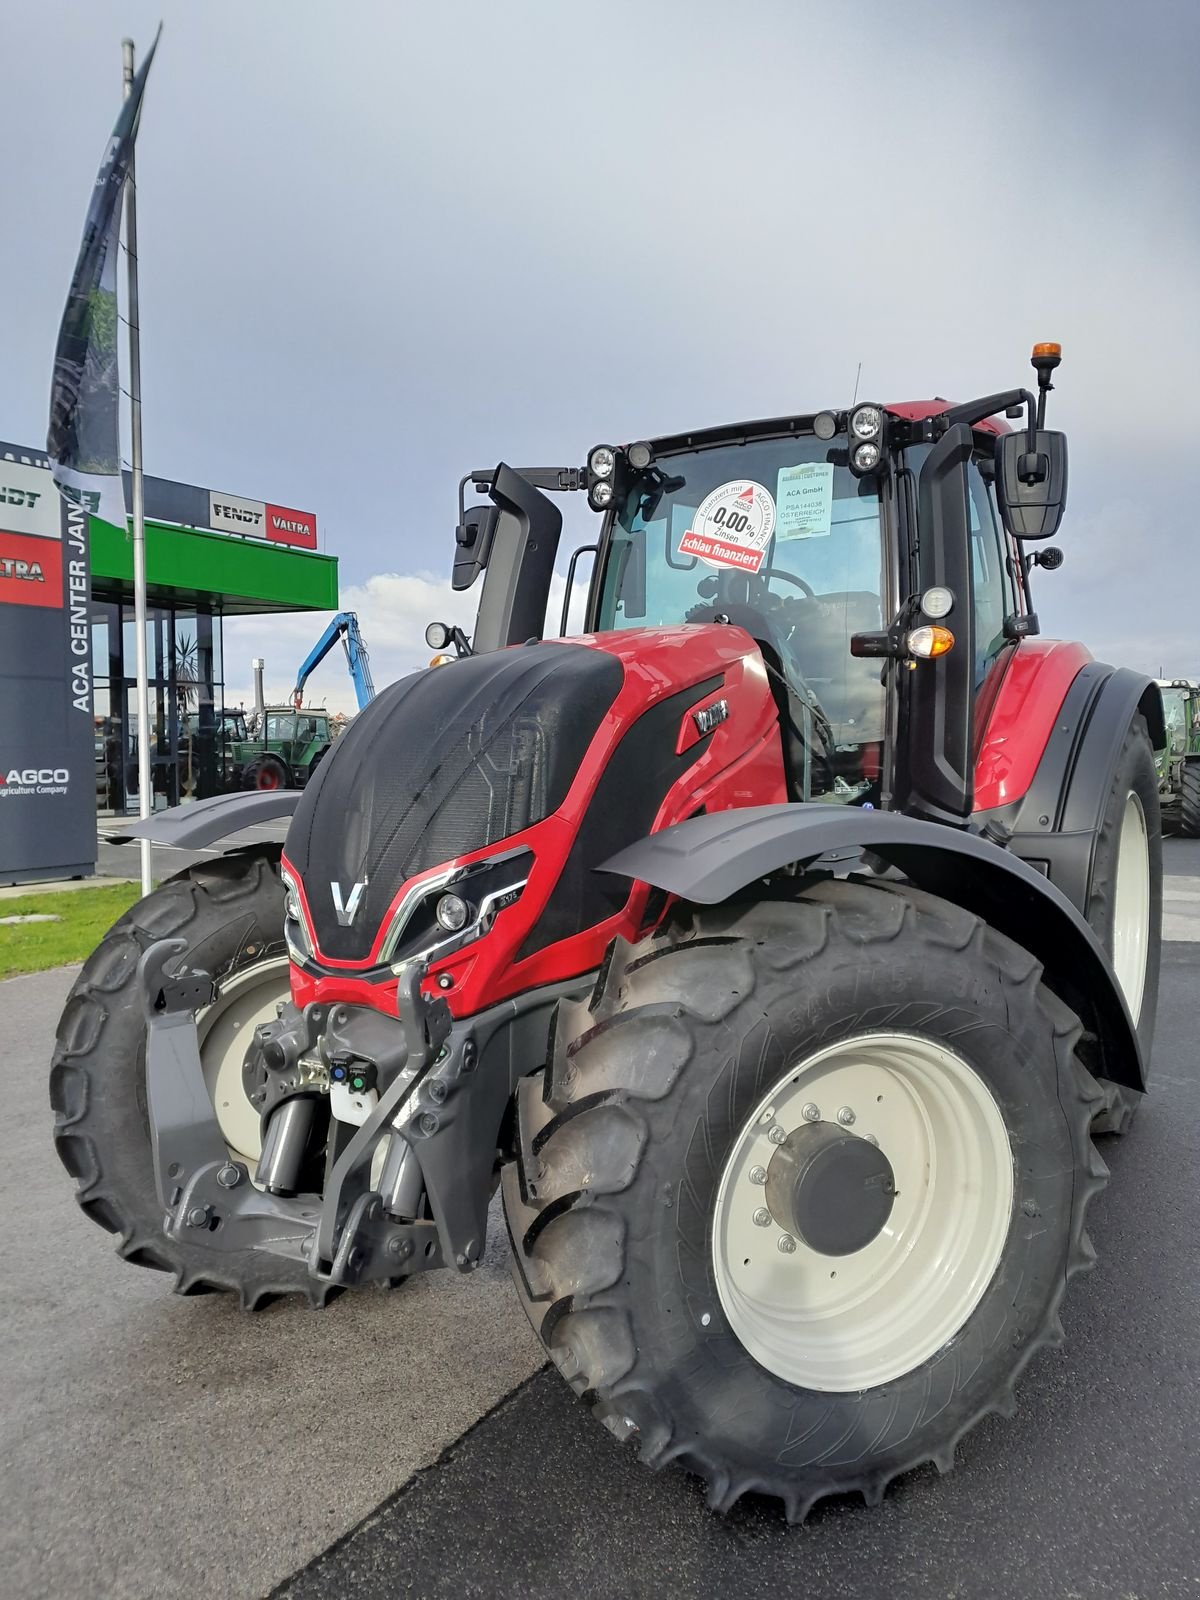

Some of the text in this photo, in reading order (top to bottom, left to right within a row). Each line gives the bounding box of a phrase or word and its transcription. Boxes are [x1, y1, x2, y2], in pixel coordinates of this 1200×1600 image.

[786, 486, 823, 497] ACA GmbH
[213, 503, 262, 525] FENDT
[755, 492, 771, 546] AGCO FINANCE
[271, 515, 311, 536] VALTRA
[714, 528, 739, 543] Zinsen
[683, 538, 759, 566] schlau finanziert
[69, 560, 88, 656] CENTER
[72, 661, 89, 713] ACA
[6, 769, 69, 784] AGCO
[0, 786, 67, 797] griculture Company
